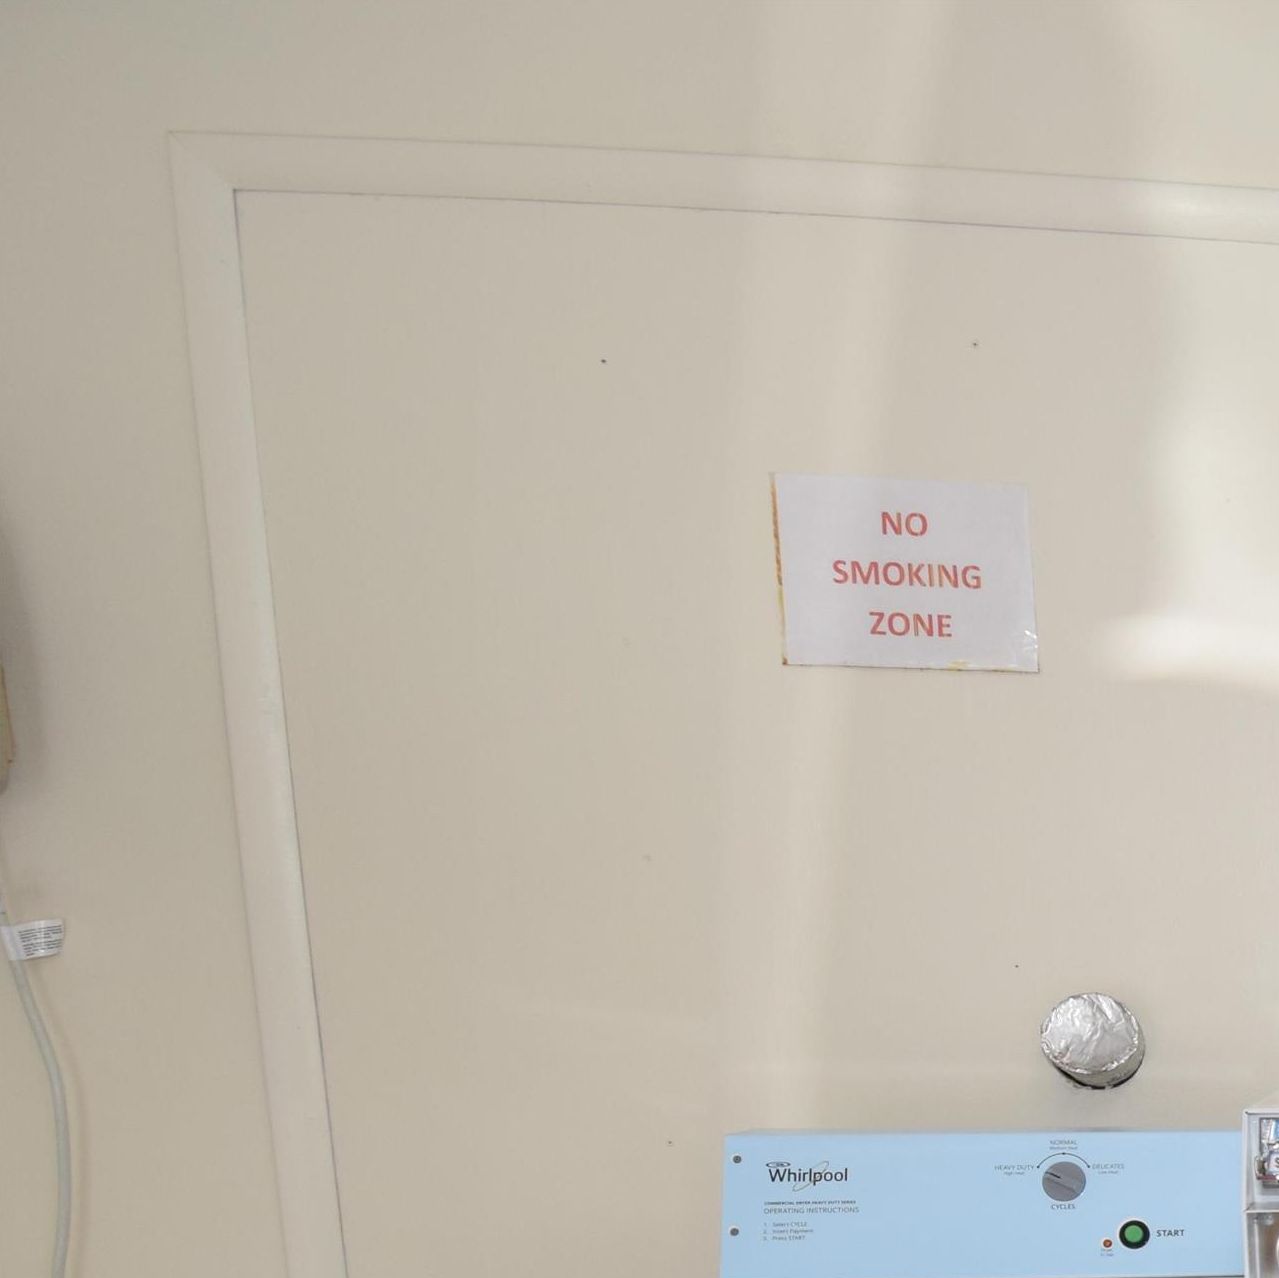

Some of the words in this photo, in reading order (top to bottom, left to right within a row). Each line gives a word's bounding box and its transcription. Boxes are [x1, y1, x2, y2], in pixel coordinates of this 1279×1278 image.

[881, 511, 928, 536] NO
[832, 560, 982, 589] SMOKING
[869, 611, 952, 637] ZONE
[768, 1167, 848, 1186] Whirlpool
[806, 1206, 860, 1214] INSTRUCTIONS
[1156, 1229, 1185, 1237] START
